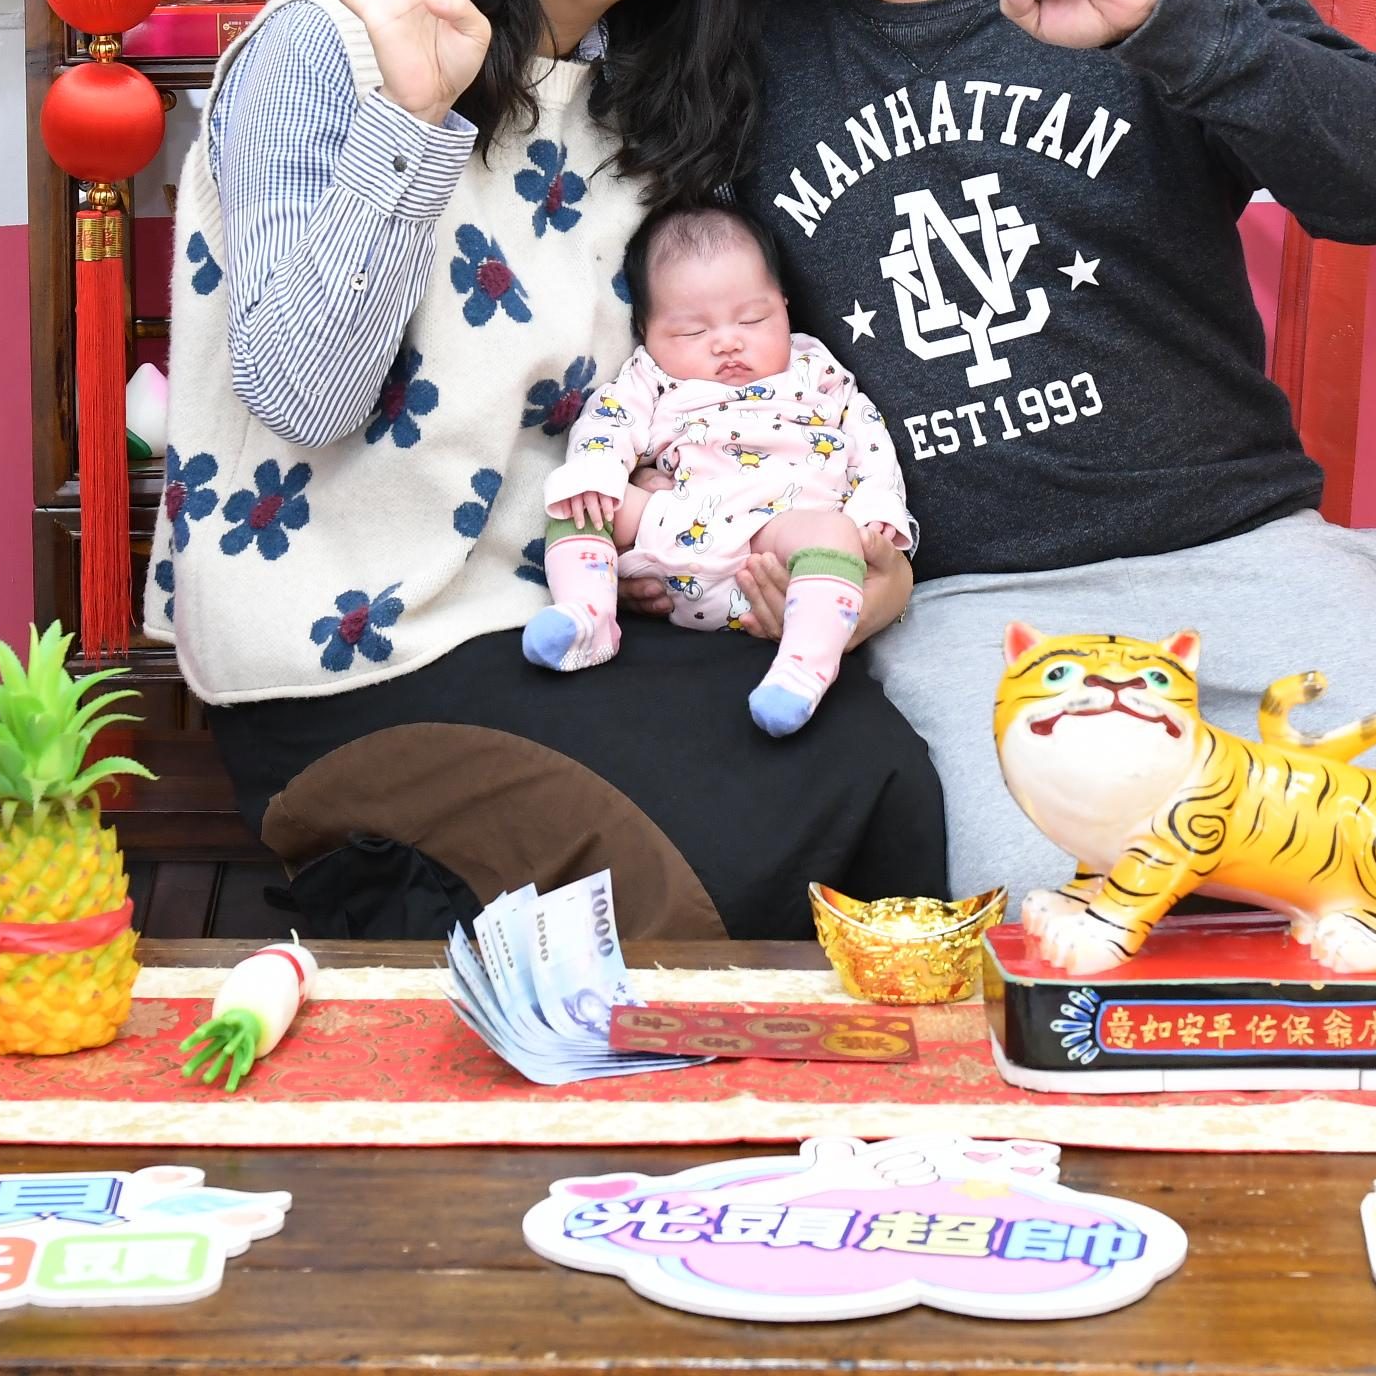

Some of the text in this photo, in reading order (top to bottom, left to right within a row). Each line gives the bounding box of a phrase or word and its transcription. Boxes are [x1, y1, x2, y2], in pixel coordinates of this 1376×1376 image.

[773, 80, 1132, 238] MANHATTAN
[536, 911, 550, 963] 1000
[590, 882, 615, 958] 1000
[564, 1197, 1149, 1269] 光頭超帥
